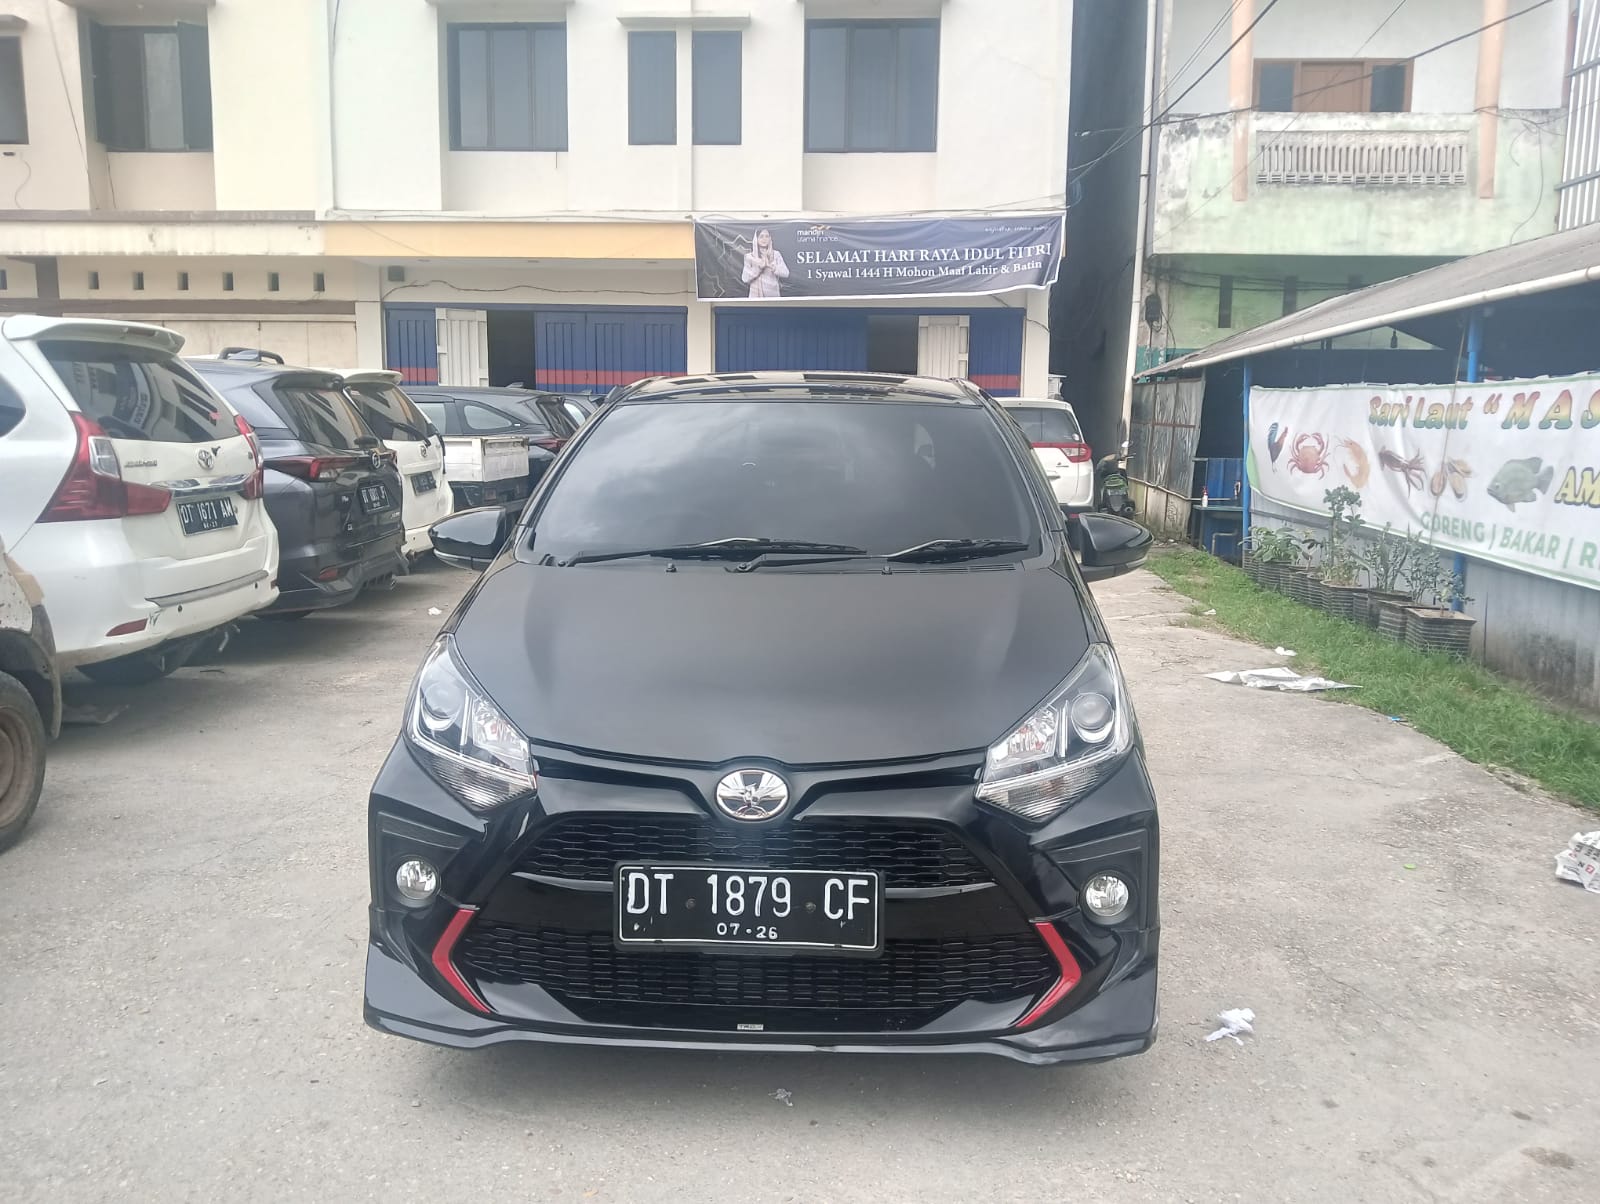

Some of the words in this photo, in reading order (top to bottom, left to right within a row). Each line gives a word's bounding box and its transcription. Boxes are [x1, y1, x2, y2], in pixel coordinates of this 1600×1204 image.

[797, 250, 870, 264] SELAMAT
[874, 249, 915, 262] HARI
[920, 248, 960, 261] RAYA
[964, 247, 1004, 260] IDUL
[1008, 243, 1052, 259] FITRI
[807, 269, 812, 278] 1
[816, 267, 852, 282] Syawal
[855, 267, 880, 278] 1444
[883, 267, 893, 277] H
[896, 266, 935, 277] Mohon
[939, 265, 966, 276] Maaf
[968, 264, 998, 275] Lahir
[1001, 265, 1010, 274] &
[1013, 260, 1042, 273] Batin
[1369, 396, 1412, 428] Sari
[1413, 396, 1474, 430] Laut
[180, 505, 195, 524] DT
[196, 502, 218, 520] 1671
[1420, 511, 1485, 543] GORENG
[1500, 526, 1561, 560] BAKAR
[626, 872, 674, 914] DT
[707, 874, 791, 918] 1879
[824, 878, 870, 920] CF
